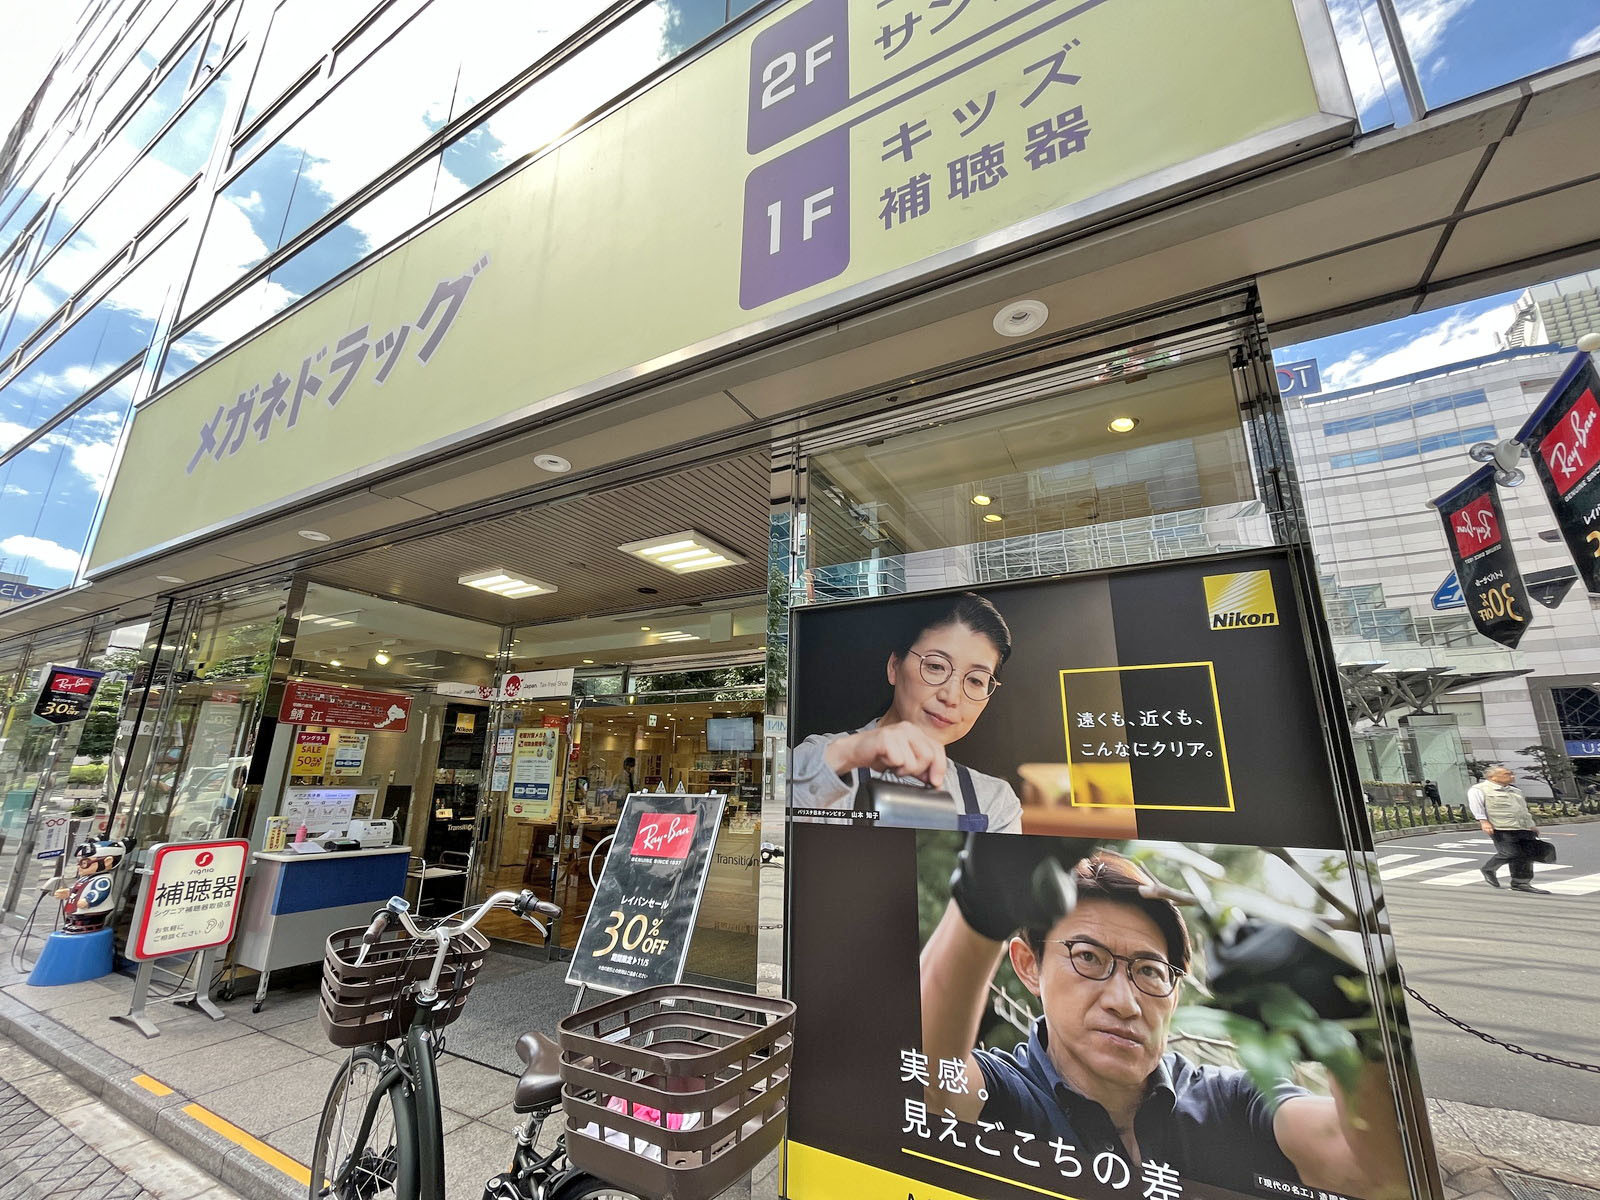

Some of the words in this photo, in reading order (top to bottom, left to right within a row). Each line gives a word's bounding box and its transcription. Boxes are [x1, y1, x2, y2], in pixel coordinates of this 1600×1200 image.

[761, 35, 834, 110] 2F
[881, 38, 1083, 163] キッズ
[878, 104, 1092, 231] 補聴器
[767, 186, 834, 256] 1F
[185, 254, 490, 476] メガネドラッグ
[1213, 609, 1277, 629] Nikon
[1076, 709, 1205, 729] 遠くも、近くも、
[301, 745, 322, 754] SALE
[1080, 740, 1216, 760] こんなにクリア。
[189, 867, 215, 876] signia
[155, 876, 237, 907] 補聴器
[155, 901, 231, 917] シグニア補聴器取扱店
[641, 937, 670, 956] OFF
[899, 1048, 991, 1100] 実感。
[902, 1099, 1184, 1200] 見えごこちの差
